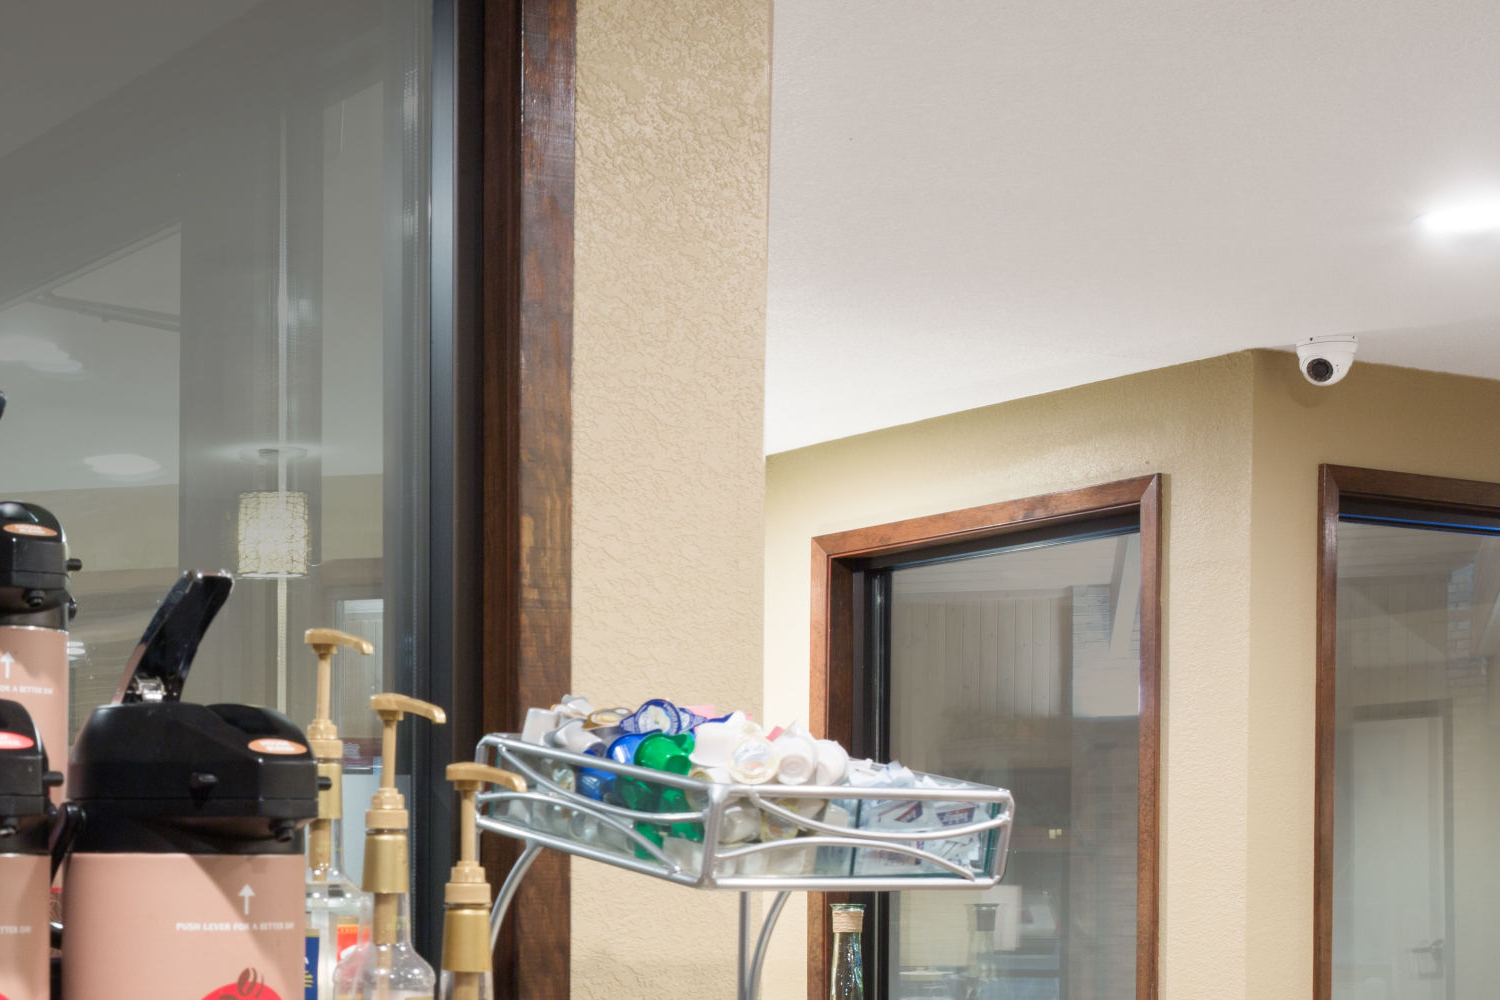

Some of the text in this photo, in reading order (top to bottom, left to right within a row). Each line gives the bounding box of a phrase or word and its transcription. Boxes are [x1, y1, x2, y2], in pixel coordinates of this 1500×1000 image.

[175, 922, 201, 931] PUSH
[202, 922, 231, 931] LEVER
[233, 922, 250, 931] FOR
